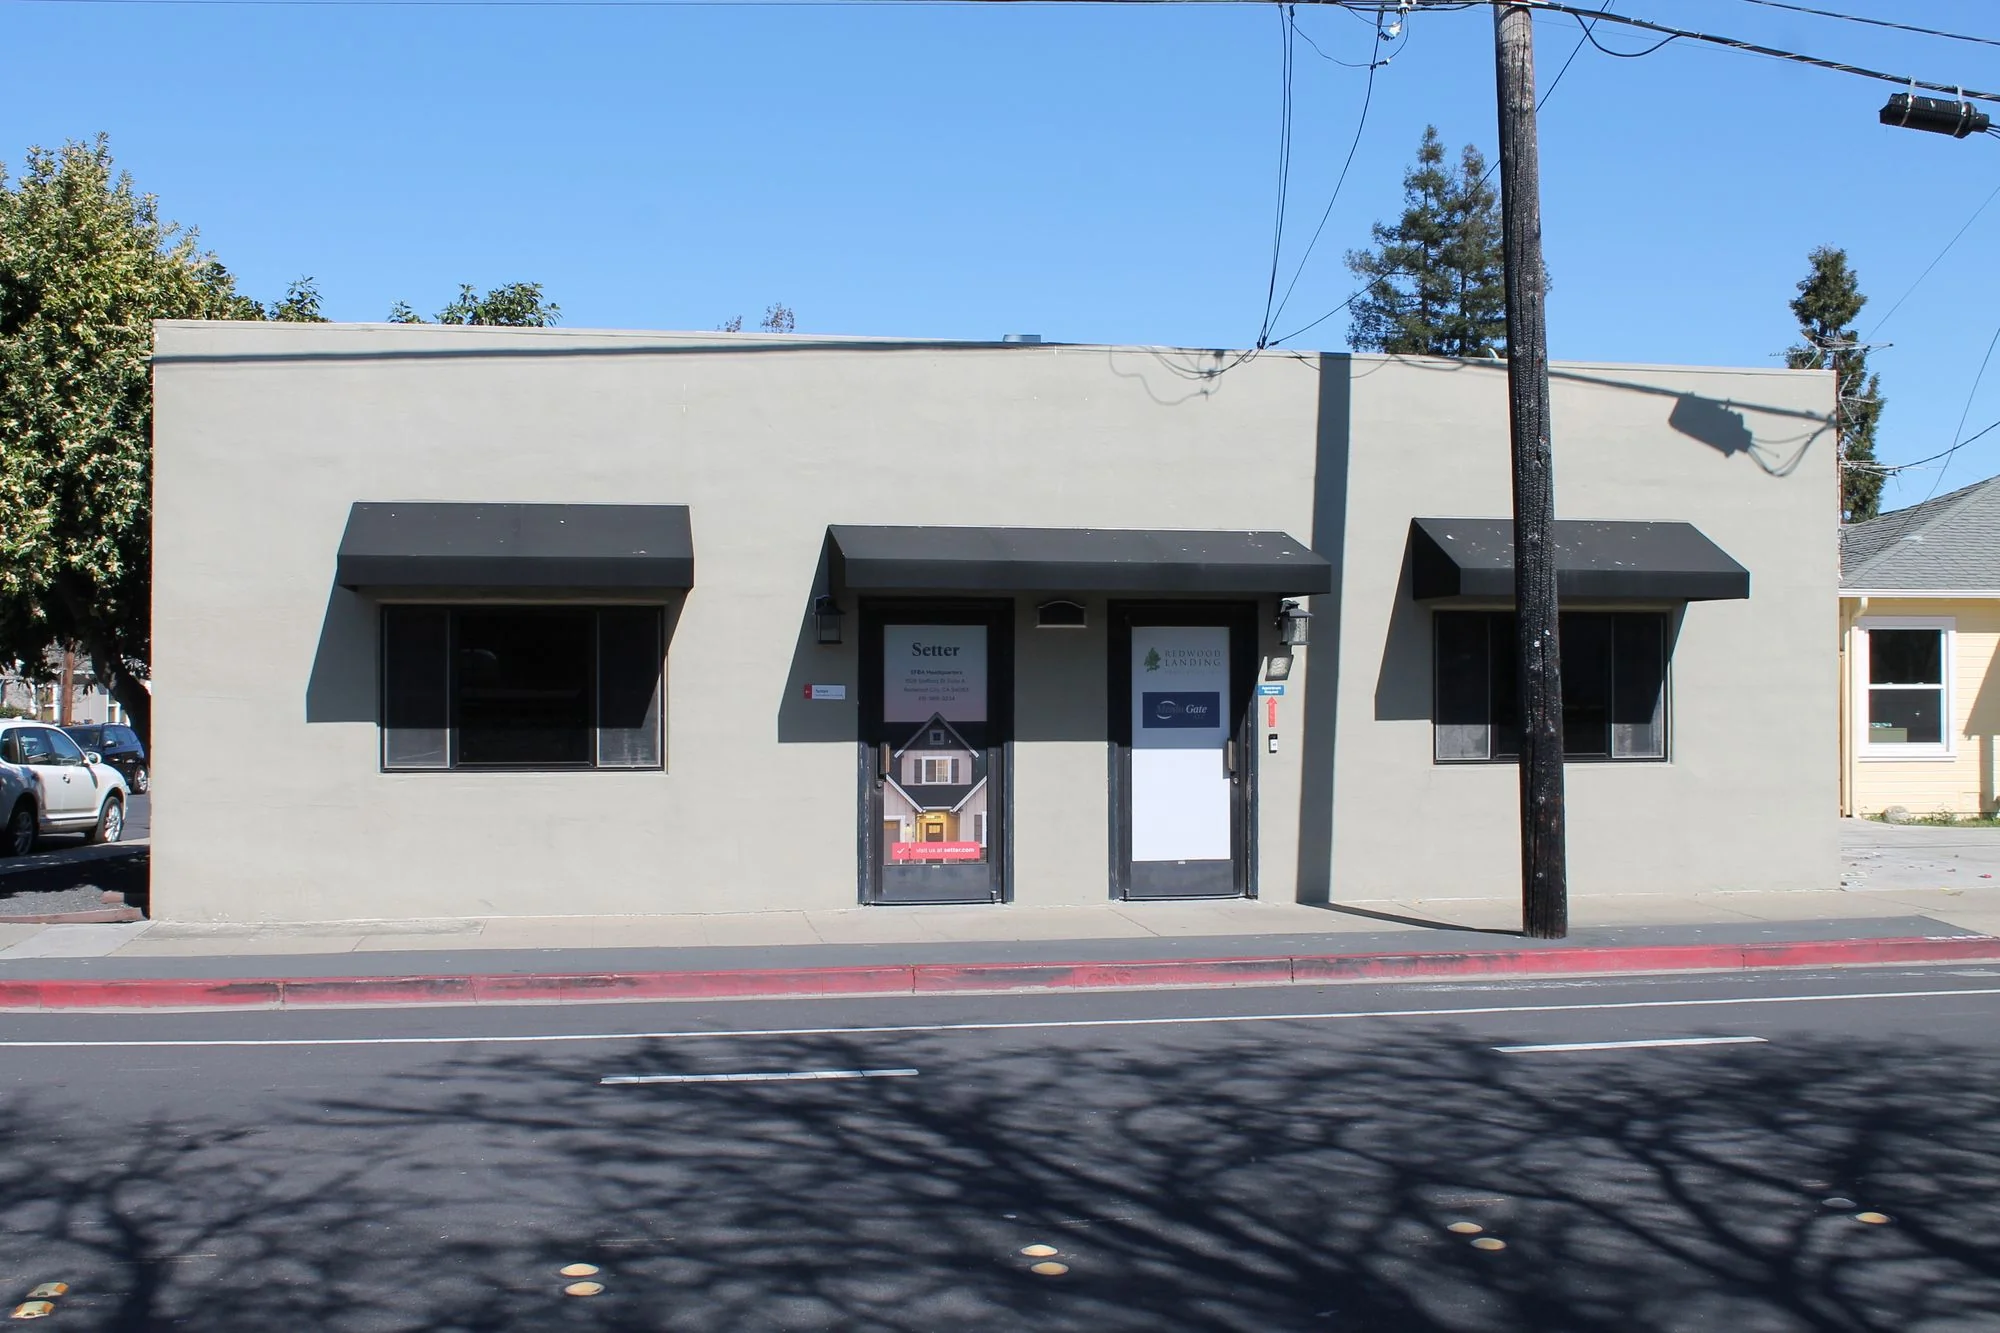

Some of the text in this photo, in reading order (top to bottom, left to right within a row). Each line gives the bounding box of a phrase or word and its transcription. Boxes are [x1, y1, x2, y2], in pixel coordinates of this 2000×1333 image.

[912, 642, 960, 657] Setter
[1165, 649, 1221, 657] REDWOOD
[1165, 659, 1221, 667] LANDING
[1185, 704, 1208, 714] Gate
